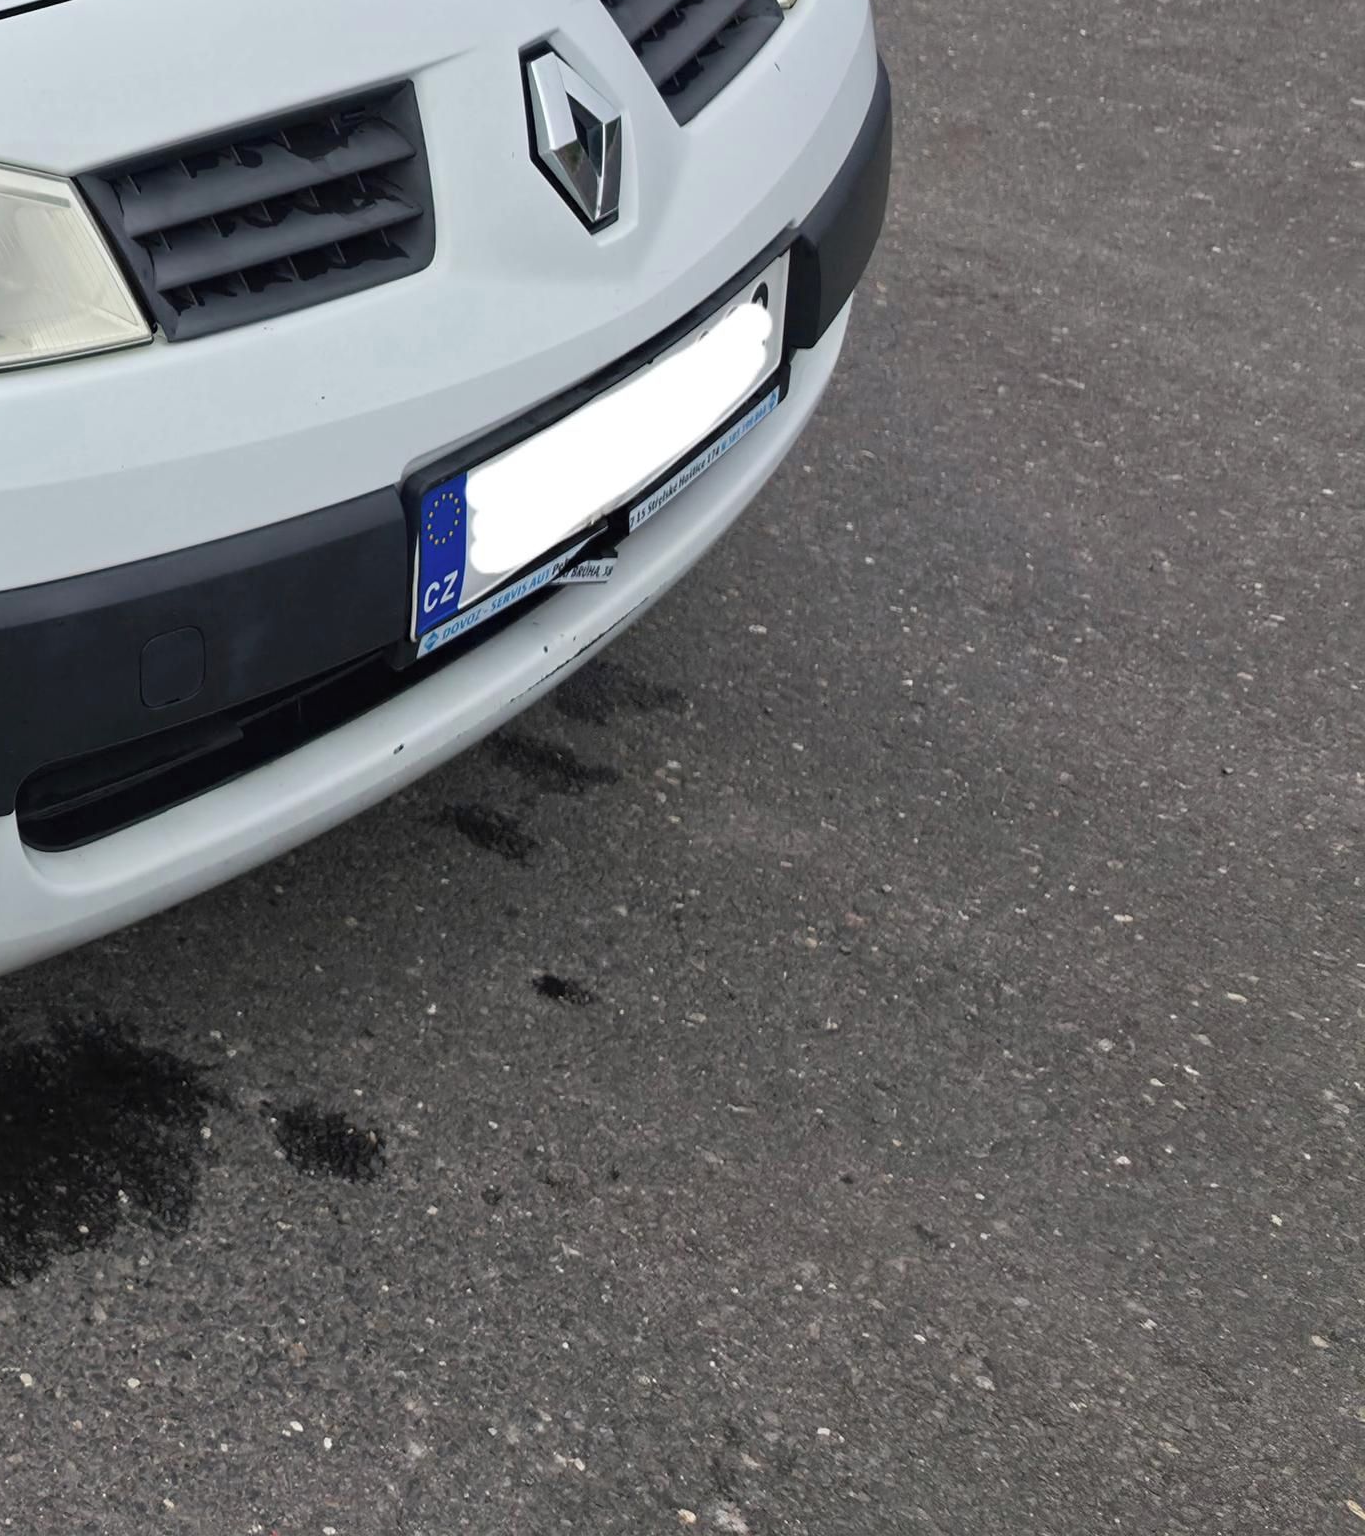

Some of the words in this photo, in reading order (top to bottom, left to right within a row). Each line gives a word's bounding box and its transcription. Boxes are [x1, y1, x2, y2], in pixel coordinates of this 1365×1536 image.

[423, 570, 459, 614] CZ
[441, 609, 482, 641] DOVOZ
[491, 584, 527, 610] SERVIS
